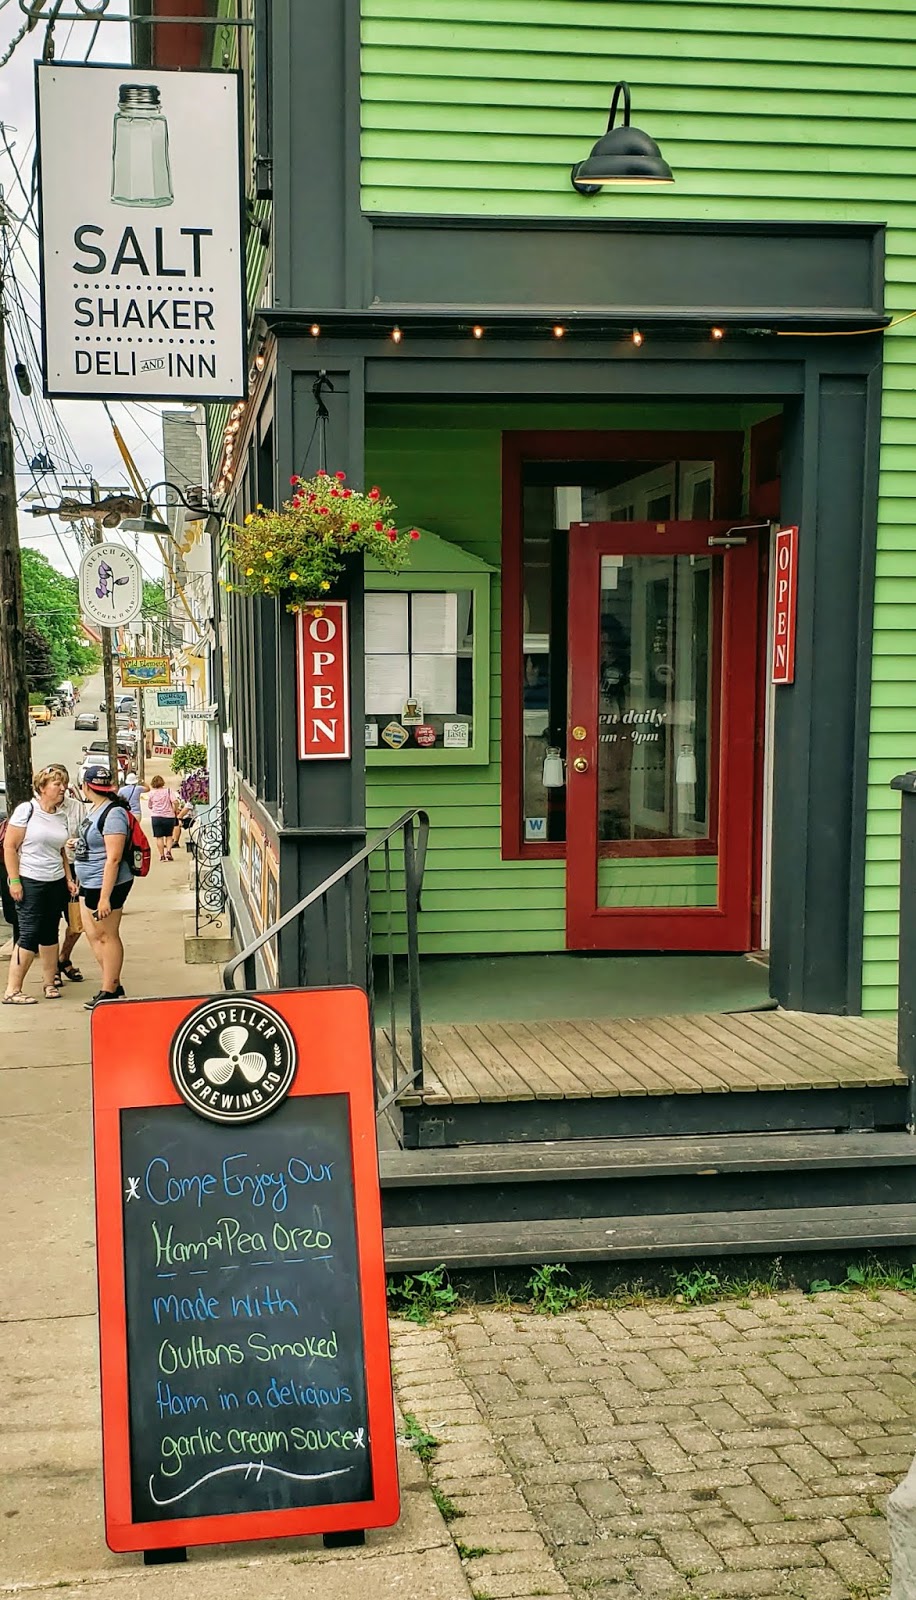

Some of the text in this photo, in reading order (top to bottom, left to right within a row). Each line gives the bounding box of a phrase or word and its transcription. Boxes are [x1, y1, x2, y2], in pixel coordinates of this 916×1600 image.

[72, 224, 213, 277] SALT
[74, 297, 215, 330] SHAKER
[75, 350, 216, 379] DELI AND INN
[87, 549, 135, 570] BEACH PEA
[775, 546, 790, 668] OPEN
[123, 660, 138, 668] Wild
[309, 617, 338, 743] OPEN
[622, 709, 667, 727] daily
[154, 746, 173, 755] OPEN
[631, 731, 659, 745] 9pm
[529, 819, 543, 831] W
[189, 1008, 277, 1045] PROPELLER
[191, 1071, 281, 1109] BREWING CO
[145, 1153, 335, 1212] Come Enjoy Our
[152, 1221, 208, 1267] Ham
[217, 1217, 267, 1256] Pea
[272, 1222, 332, 1251] Orzo
[231, 1285, 299, 1317] with
[158, 1331, 339, 1374] Oultons Smoked
[156, 1380, 208, 1419] Ham
[218, 1387, 239, 1410] in
[246, 1391, 262, 1409] a
[160, 1426, 224, 1477] garlic
